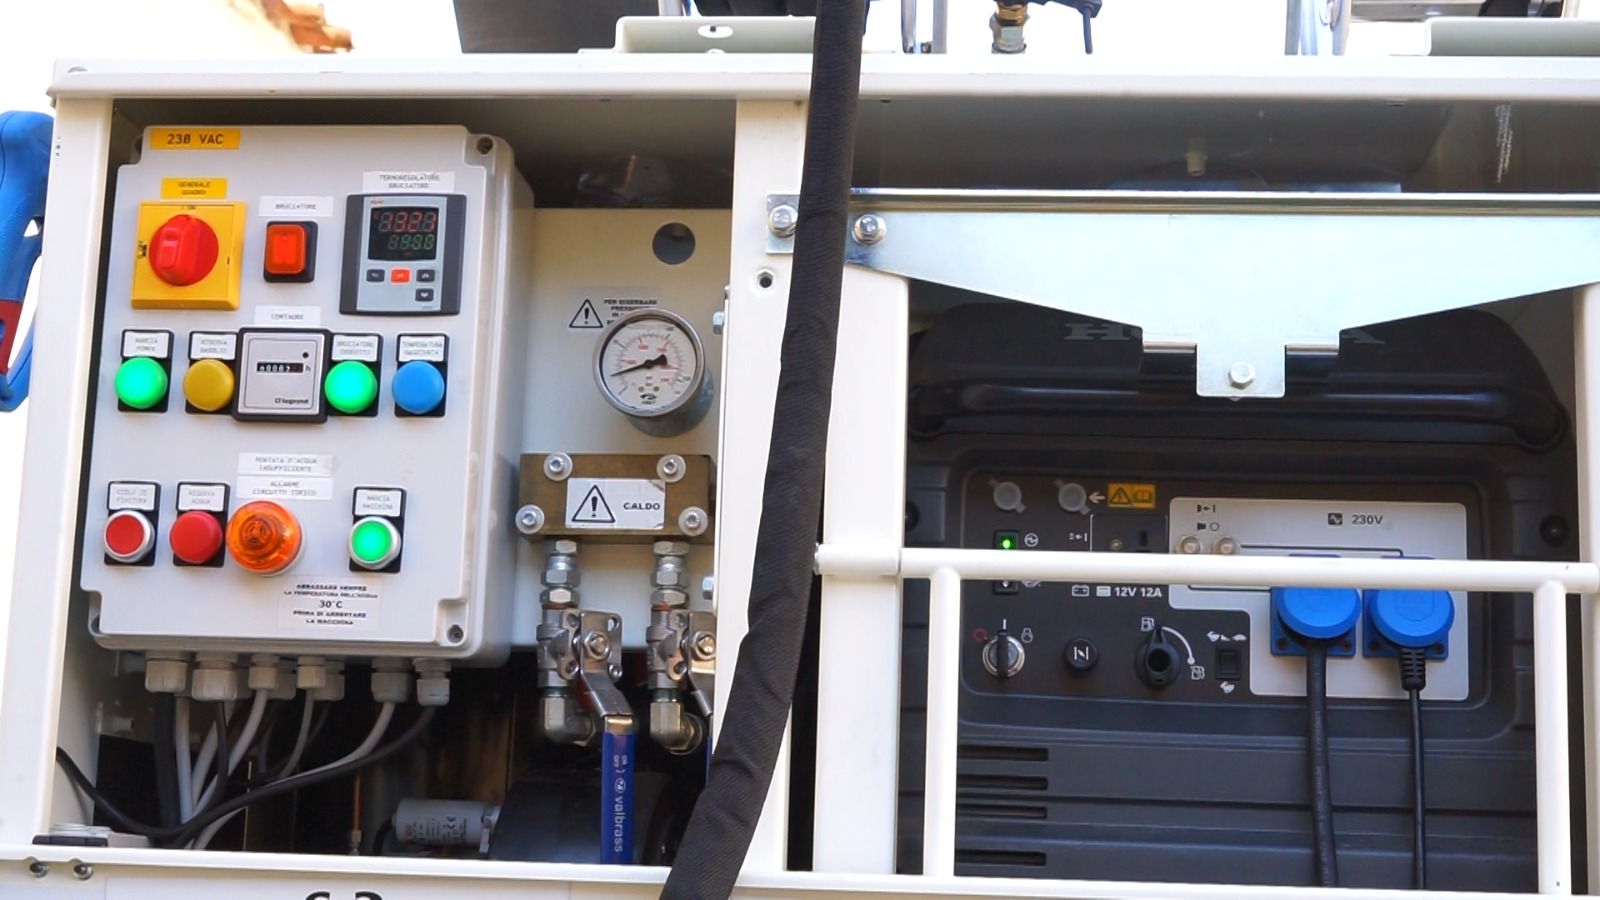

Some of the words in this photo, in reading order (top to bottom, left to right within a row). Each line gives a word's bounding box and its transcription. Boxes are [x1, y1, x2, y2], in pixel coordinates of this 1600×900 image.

[167, 133, 191, 145] 230
[199, 133, 224, 145] VAC
[623, 502, 661, 510] CALDO
[1351, 514, 1384, 525] 230V
[1114, 586, 1137, 597] 12V
[1140, 587, 1163, 598] 12A
[319, 600, 343, 608] 30°C
[614, 795, 626, 852] valbrass
